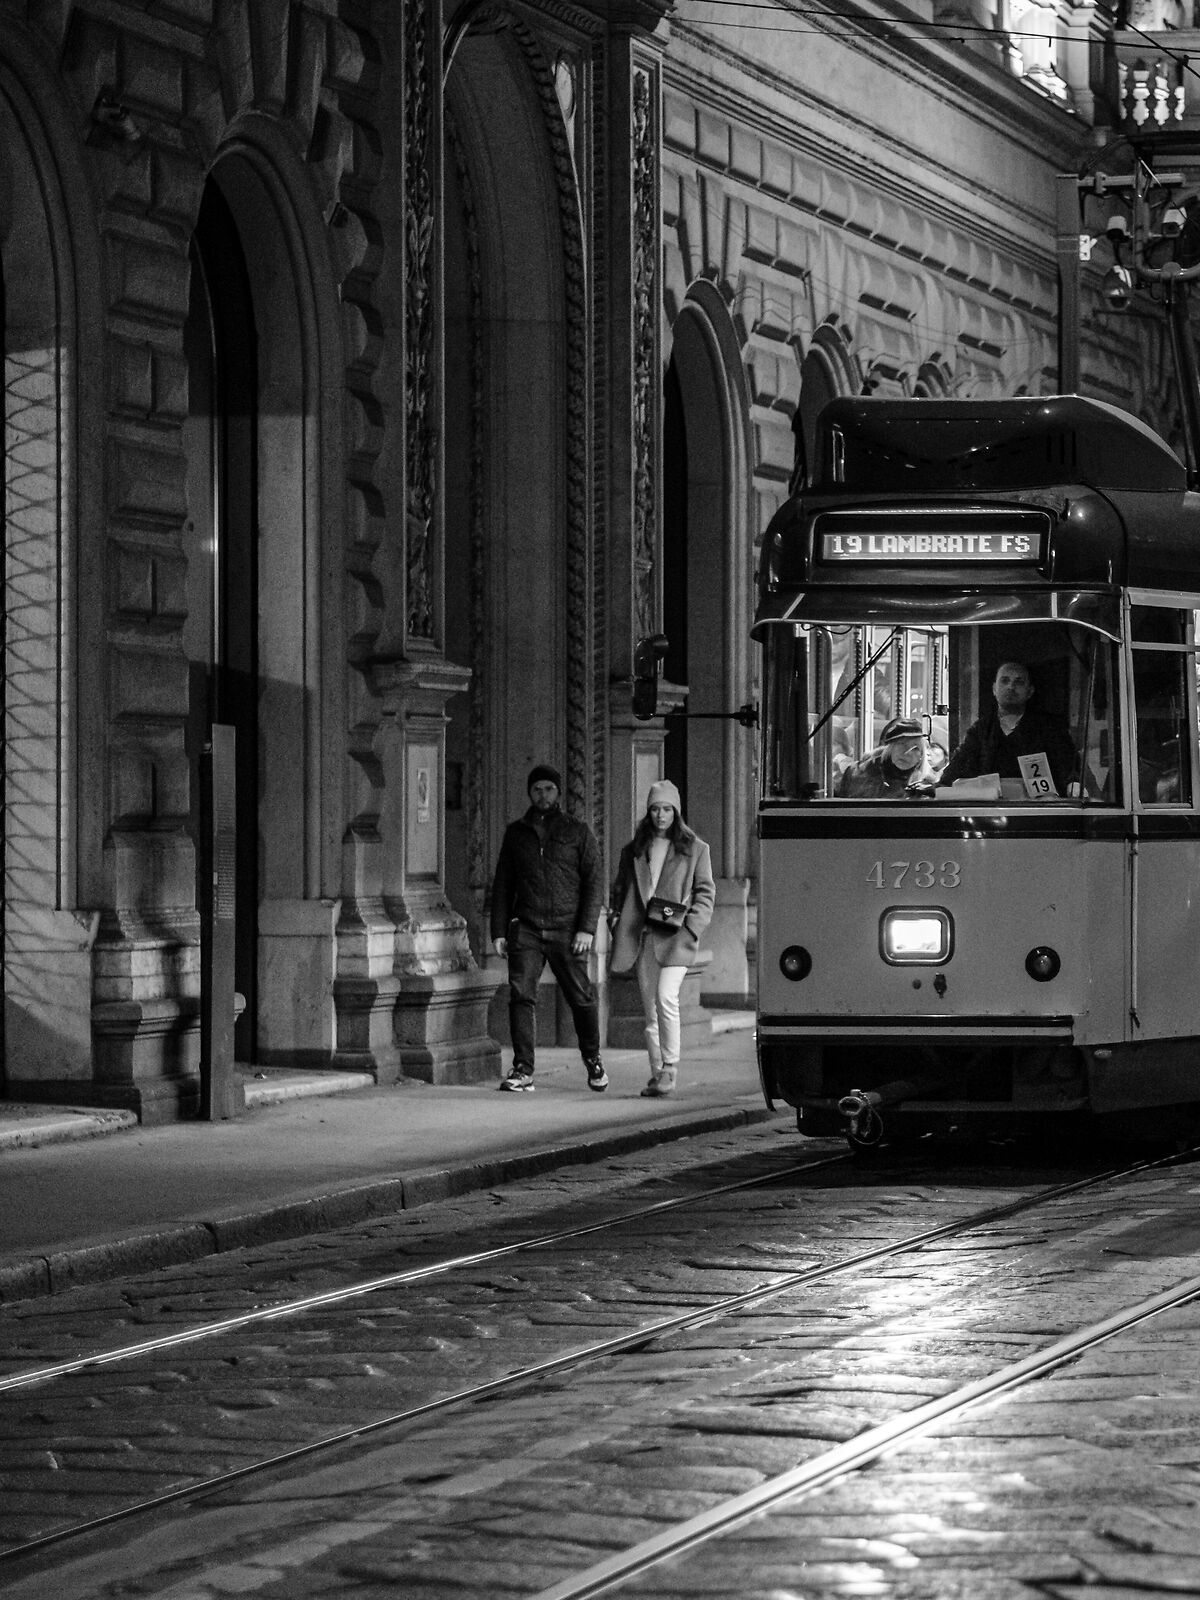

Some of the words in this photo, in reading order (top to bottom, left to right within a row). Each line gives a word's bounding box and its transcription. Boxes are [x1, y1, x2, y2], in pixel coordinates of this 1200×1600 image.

[833, 535, 862, 553] 19
[869, 535, 992, 553] LAMBRATE
[1001, 535, 1031, 553] FS
[1031, 763, 1042, 777] 2
[1032, 779, 1050, 793] 19
[865, 860, 962, 889] 4733
